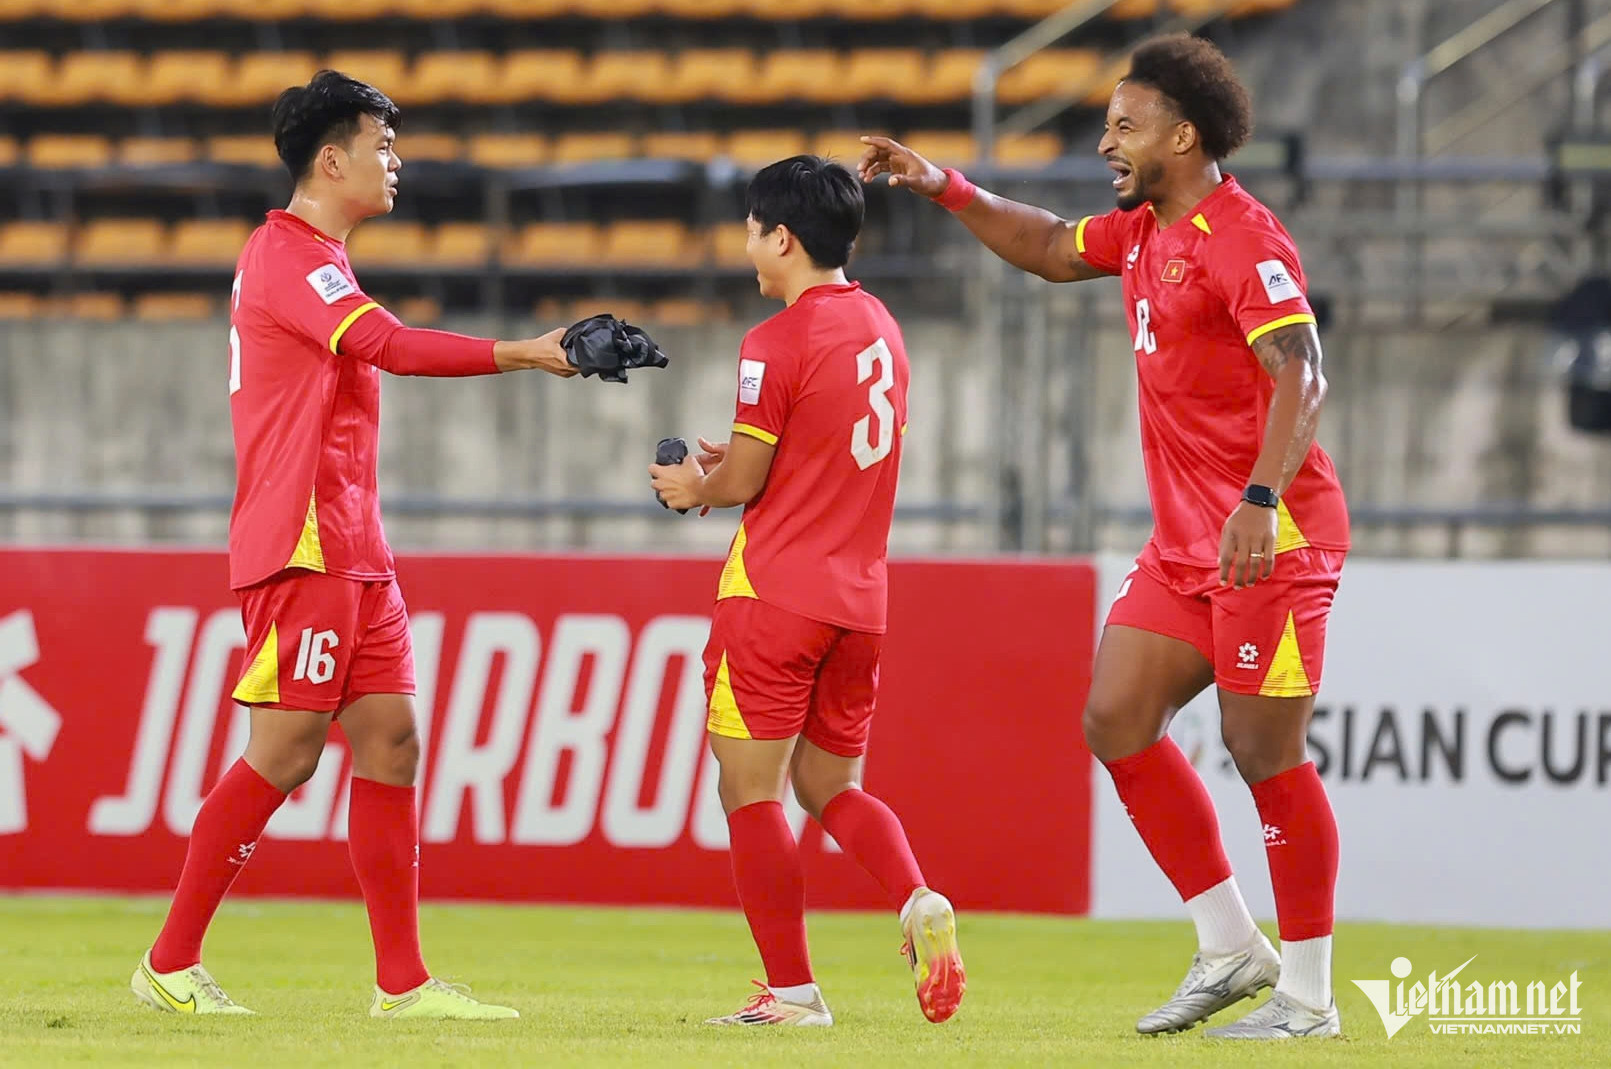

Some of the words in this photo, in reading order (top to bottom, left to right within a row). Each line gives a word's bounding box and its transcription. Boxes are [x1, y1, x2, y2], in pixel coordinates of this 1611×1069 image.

[850, 337, 895, 471] 3
[292, 627, 339, 685] 16
[1303, 706, 1468, 784] SIAN
